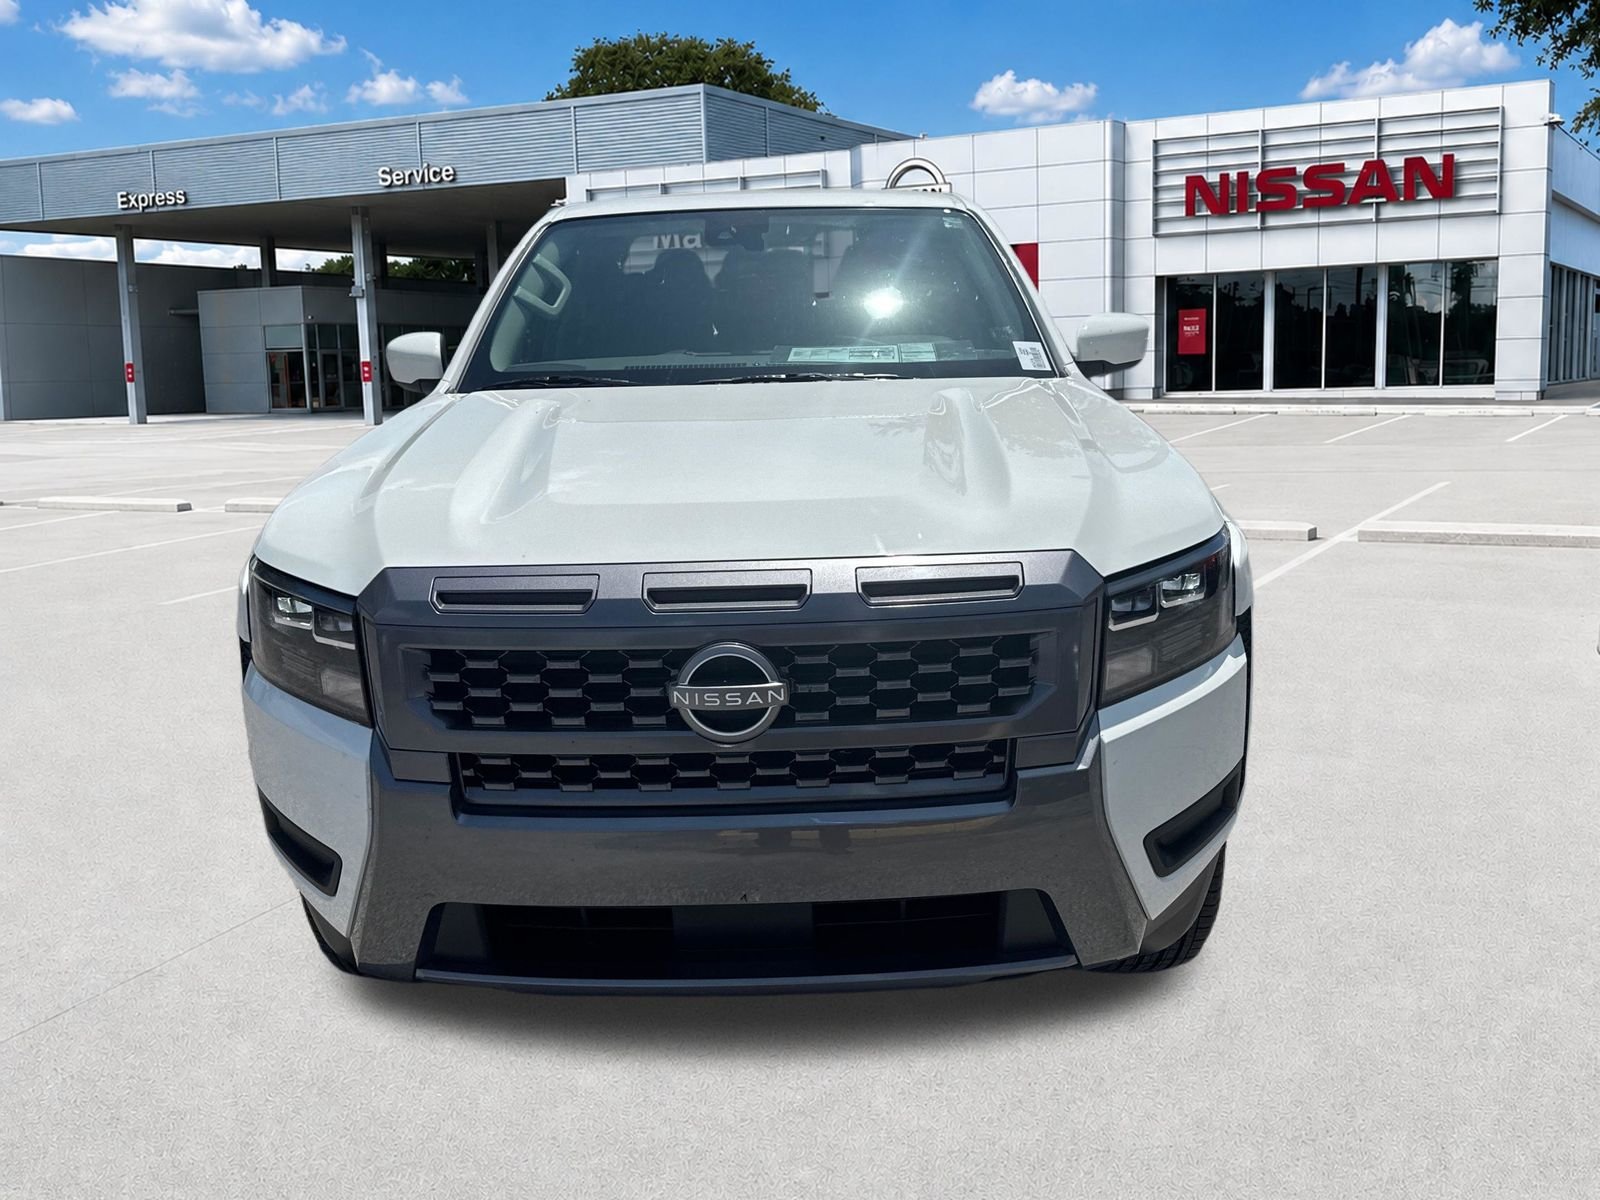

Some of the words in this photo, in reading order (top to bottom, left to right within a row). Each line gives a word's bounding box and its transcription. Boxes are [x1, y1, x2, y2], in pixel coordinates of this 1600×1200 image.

[378, 163, 454, 187] Service
[1185, 153, 1455, 217] NISSAN
[117, 190, 186, 212] Express
[673, 688, 785, 706] NISSAN
